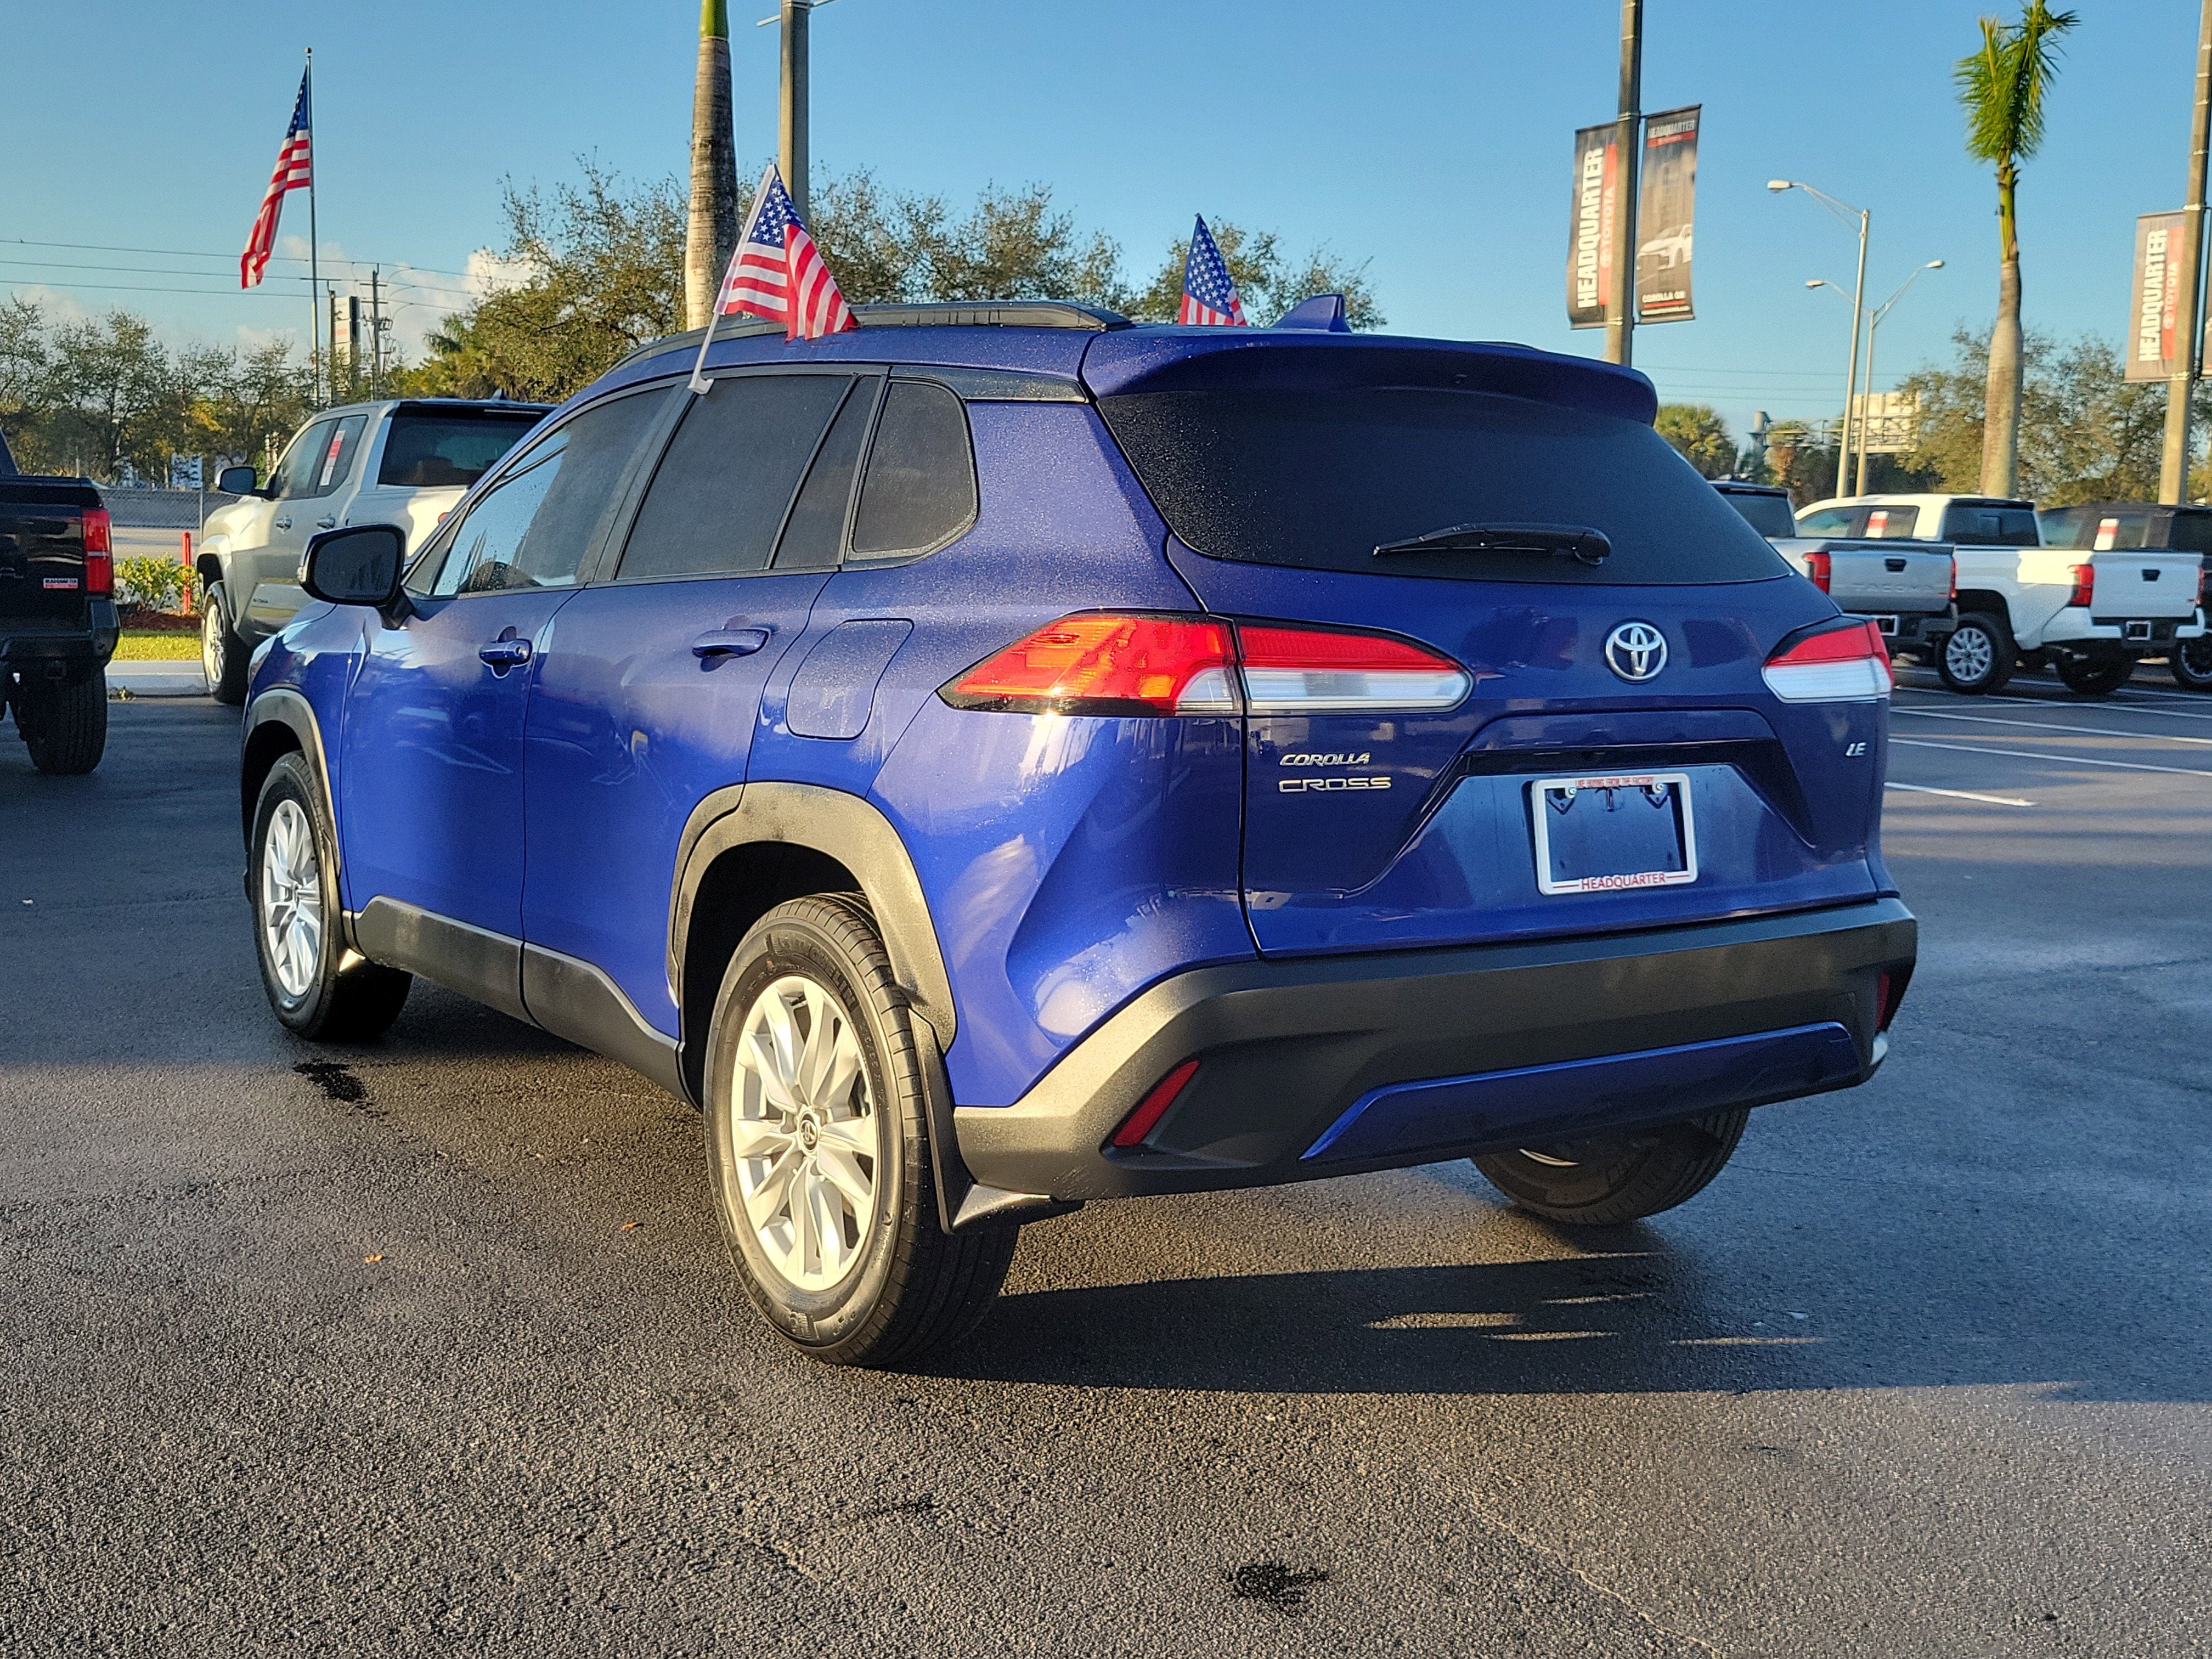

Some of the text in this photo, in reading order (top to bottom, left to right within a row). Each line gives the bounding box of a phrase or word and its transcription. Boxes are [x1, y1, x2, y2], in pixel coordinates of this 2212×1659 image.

[1577, 147, 1604, 308] HEADQUARTER
[1601, 187, 1614, 247] TOYOTA
[2138, 228, 2168, 362] HEADQUARTER
[2164, 261, 2179, 313] TOYOTA
[1279, 752, 1370, 767] COROLLA
[1846, 742, 1867, 756] LE
[1278, 776, 1392, 793] CROSS
[1581, 873, 1666, 890] HEADQUARTER
